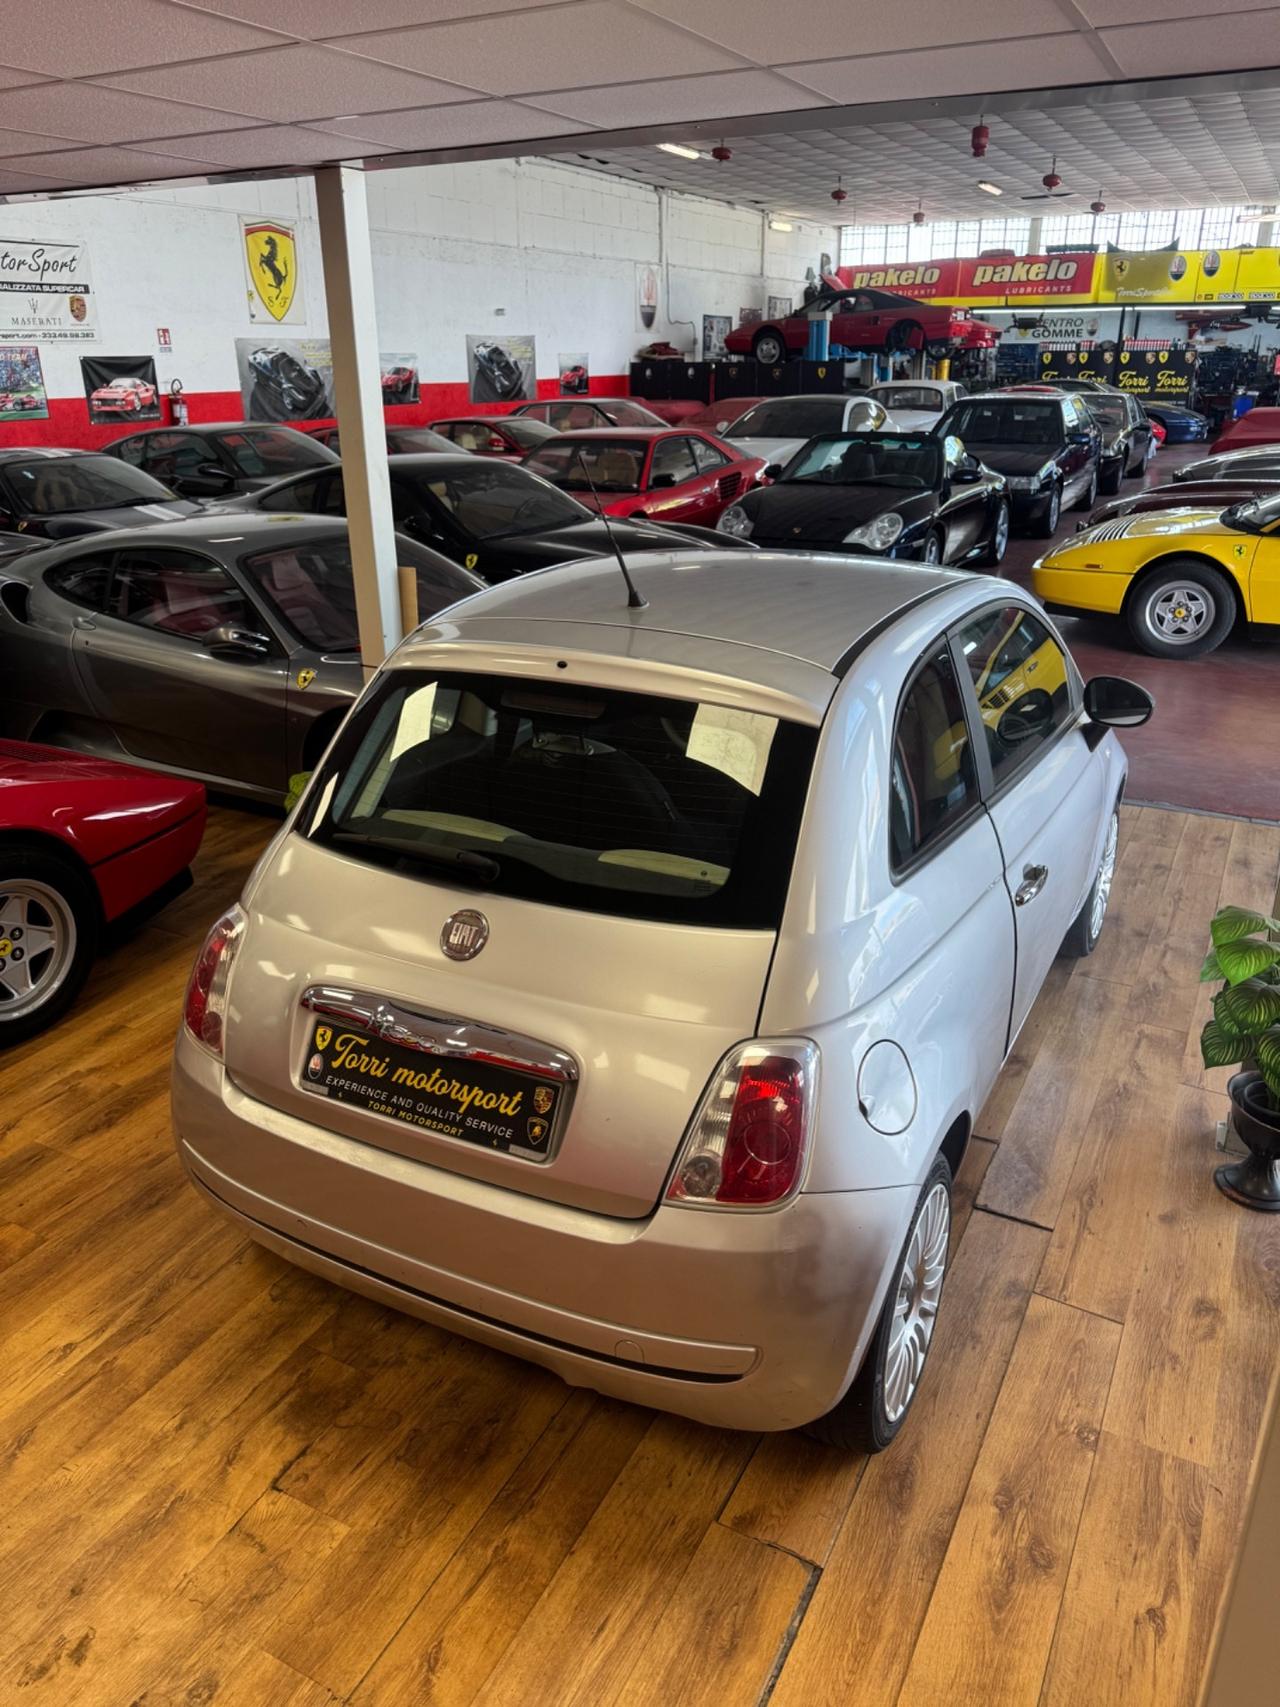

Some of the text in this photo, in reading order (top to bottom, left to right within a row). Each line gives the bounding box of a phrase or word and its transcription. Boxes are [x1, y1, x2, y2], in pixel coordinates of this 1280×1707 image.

[853, 265, 941, 288] pakelo
[972, 259, 1077, 287] pakelo
[1005, 285, 1072, 294] LUBRICANTS
[11, 317, 62, 326] MASERATI
[1043, 318, 1084, 328] ENTRO
[1032, 328, 1083, 338] GOMME
[1119, 370, 1149, 387] Torri
[1156, 370, 1188, 387] Torri
[449, 922, 479, 947] FIAT
[331, 1034, 523, 1116] Torri motorsport
[325, 1075, 514, 1139] EXPERIENCE AND QUALITY SERVICE
[368, 1100, 464, 1137] TORRI MOTORSPORT
